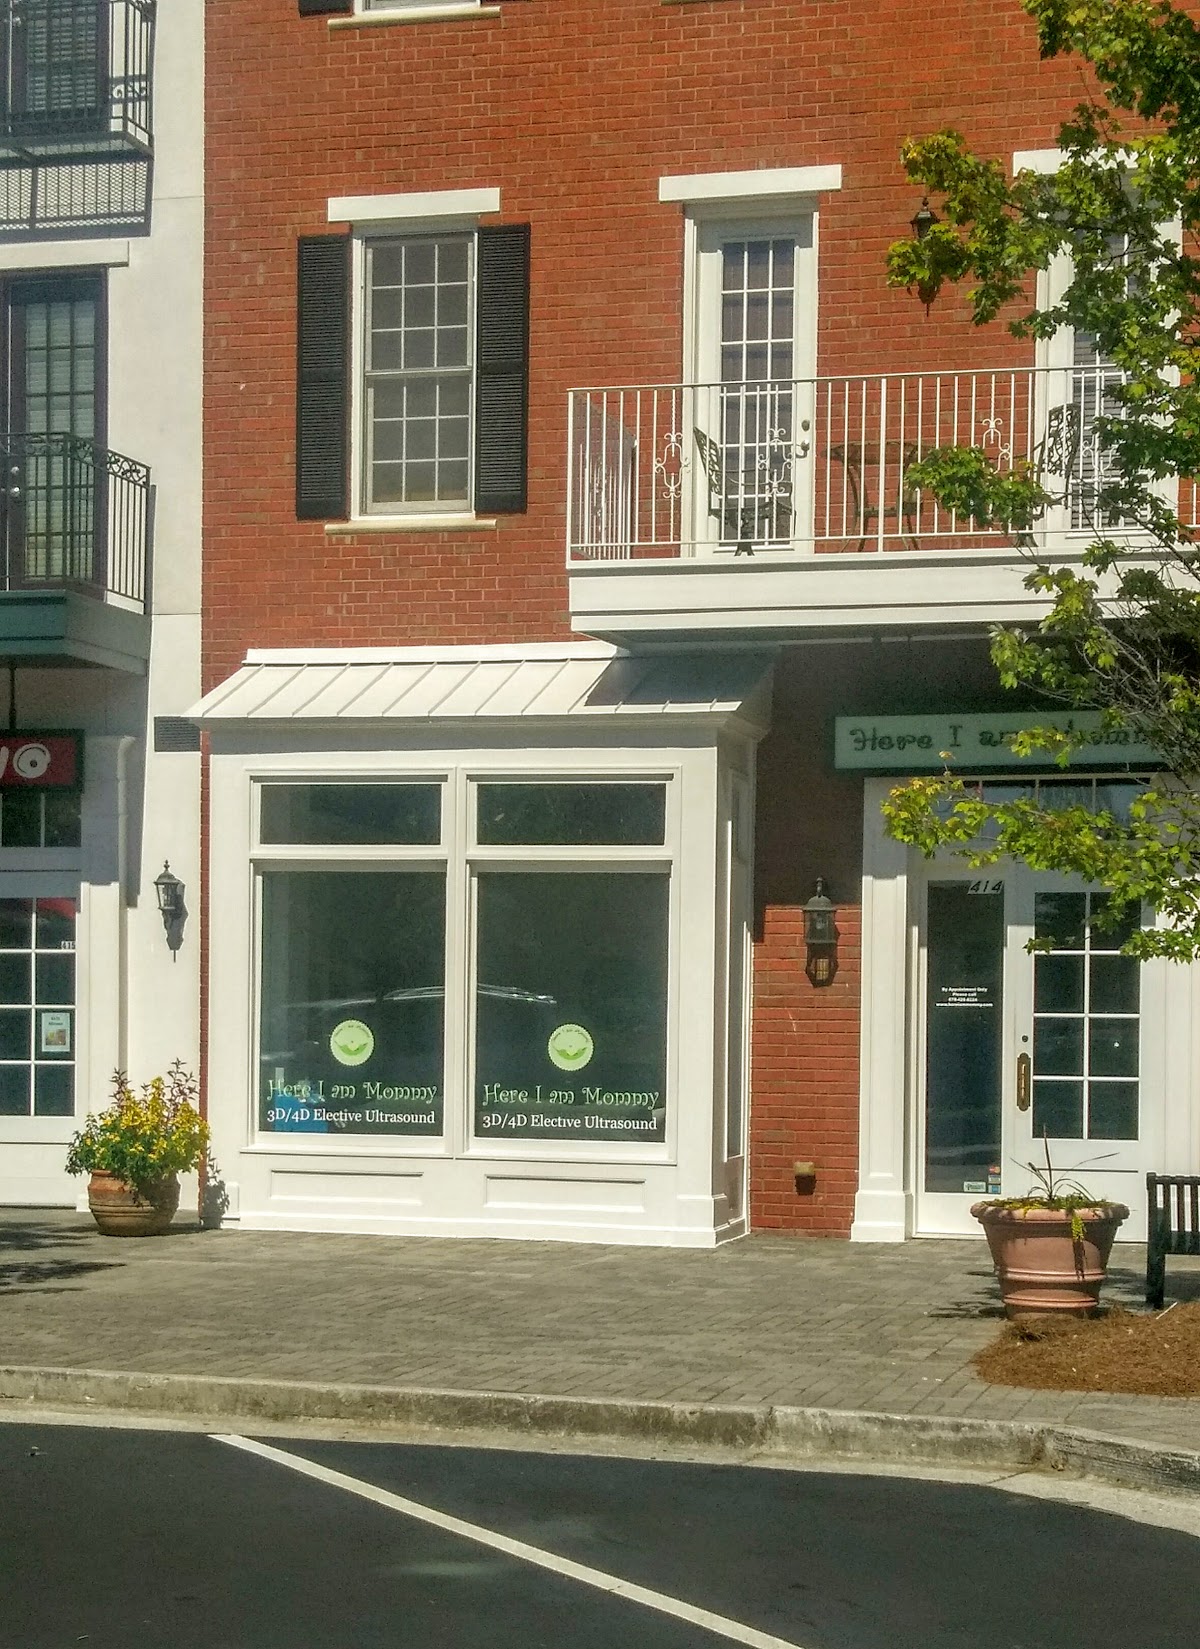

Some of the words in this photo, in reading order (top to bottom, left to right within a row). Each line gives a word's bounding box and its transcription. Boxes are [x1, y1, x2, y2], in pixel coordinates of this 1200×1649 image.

[849, 726, 934, 751] Here
[949, 725, 963, 747] I
[970, 880, 1003, 893] 414
[267, 1079, 312, 1100] Here
[318, 1079, 325, 1099] I
[331, 1086, 356, 1099] am
[363, 1081, 438, 1104] Mommy
[482, 1083, 528, 1106] Here
[535, 1084, 542, 1104] I
[549, 1090, 575, 1104] am
[582, 1086, 660, 1110] Mommy
[267, 1108, 310, 1123] 3D/4D
[313, 1108, 362, 1122] Elective
[365, 1110, 436, 1124] Ultrasound
[482, 1113, 528, 1129] 3D/4D
[531, 1113, 582, 1128] Elective
[584, 1115, 658, 1130] Ultrasound
